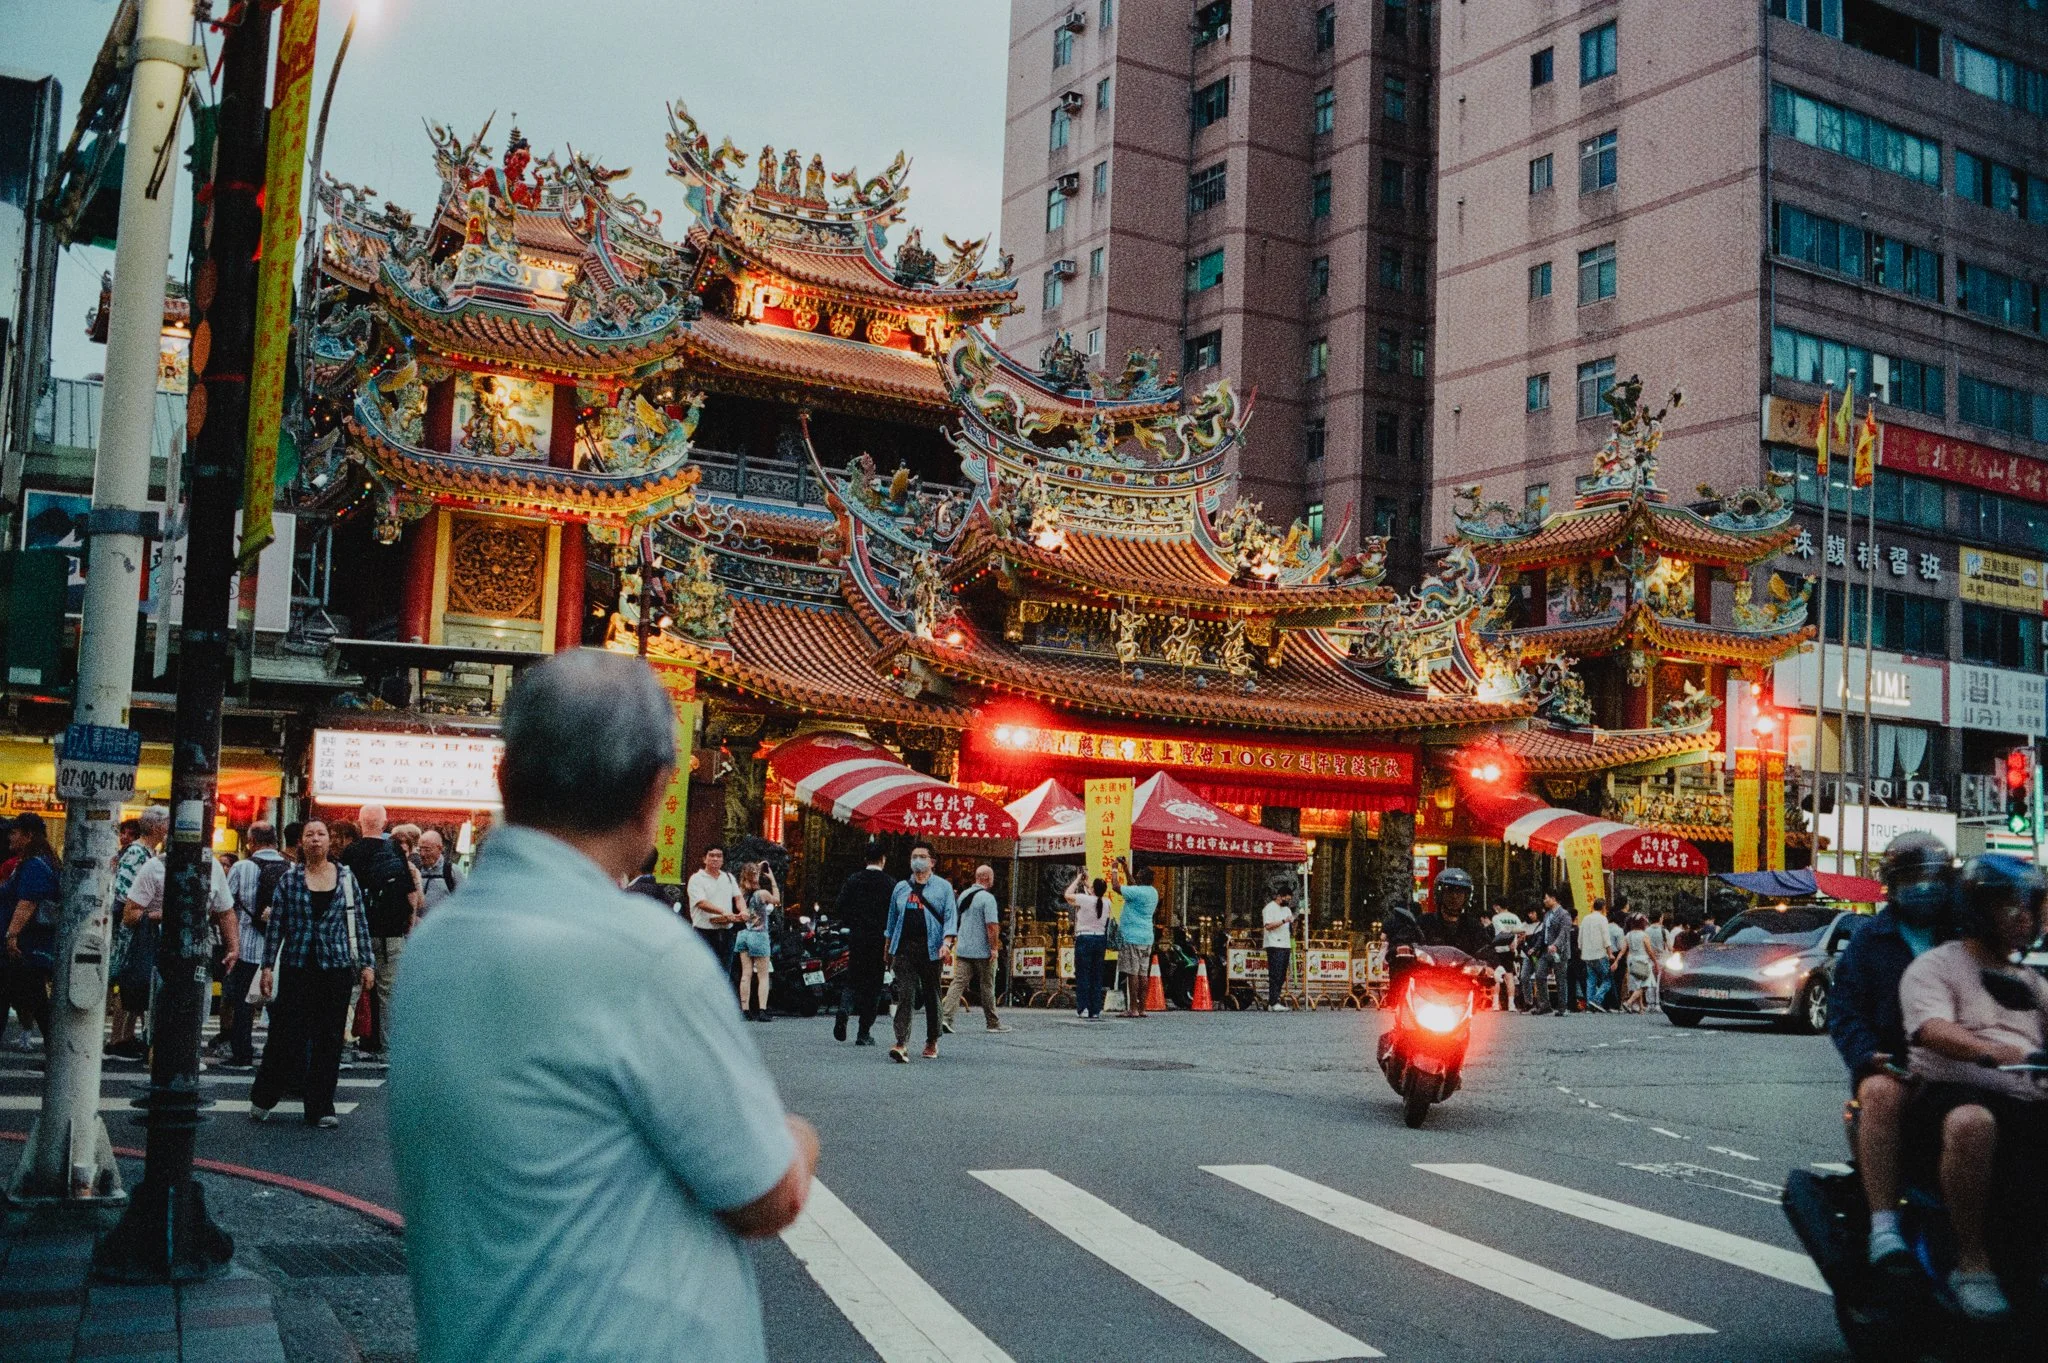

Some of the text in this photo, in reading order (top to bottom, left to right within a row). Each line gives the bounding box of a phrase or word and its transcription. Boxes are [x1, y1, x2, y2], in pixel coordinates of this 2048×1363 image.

[1917, 438, 2048, 494] 台北市松山慈祐
[62, 768, 134, 791] 07:00-01:00
[903, 808, 989, 831] 松山慈祐宮
[1871, 824, 1898, 838] TRUE
